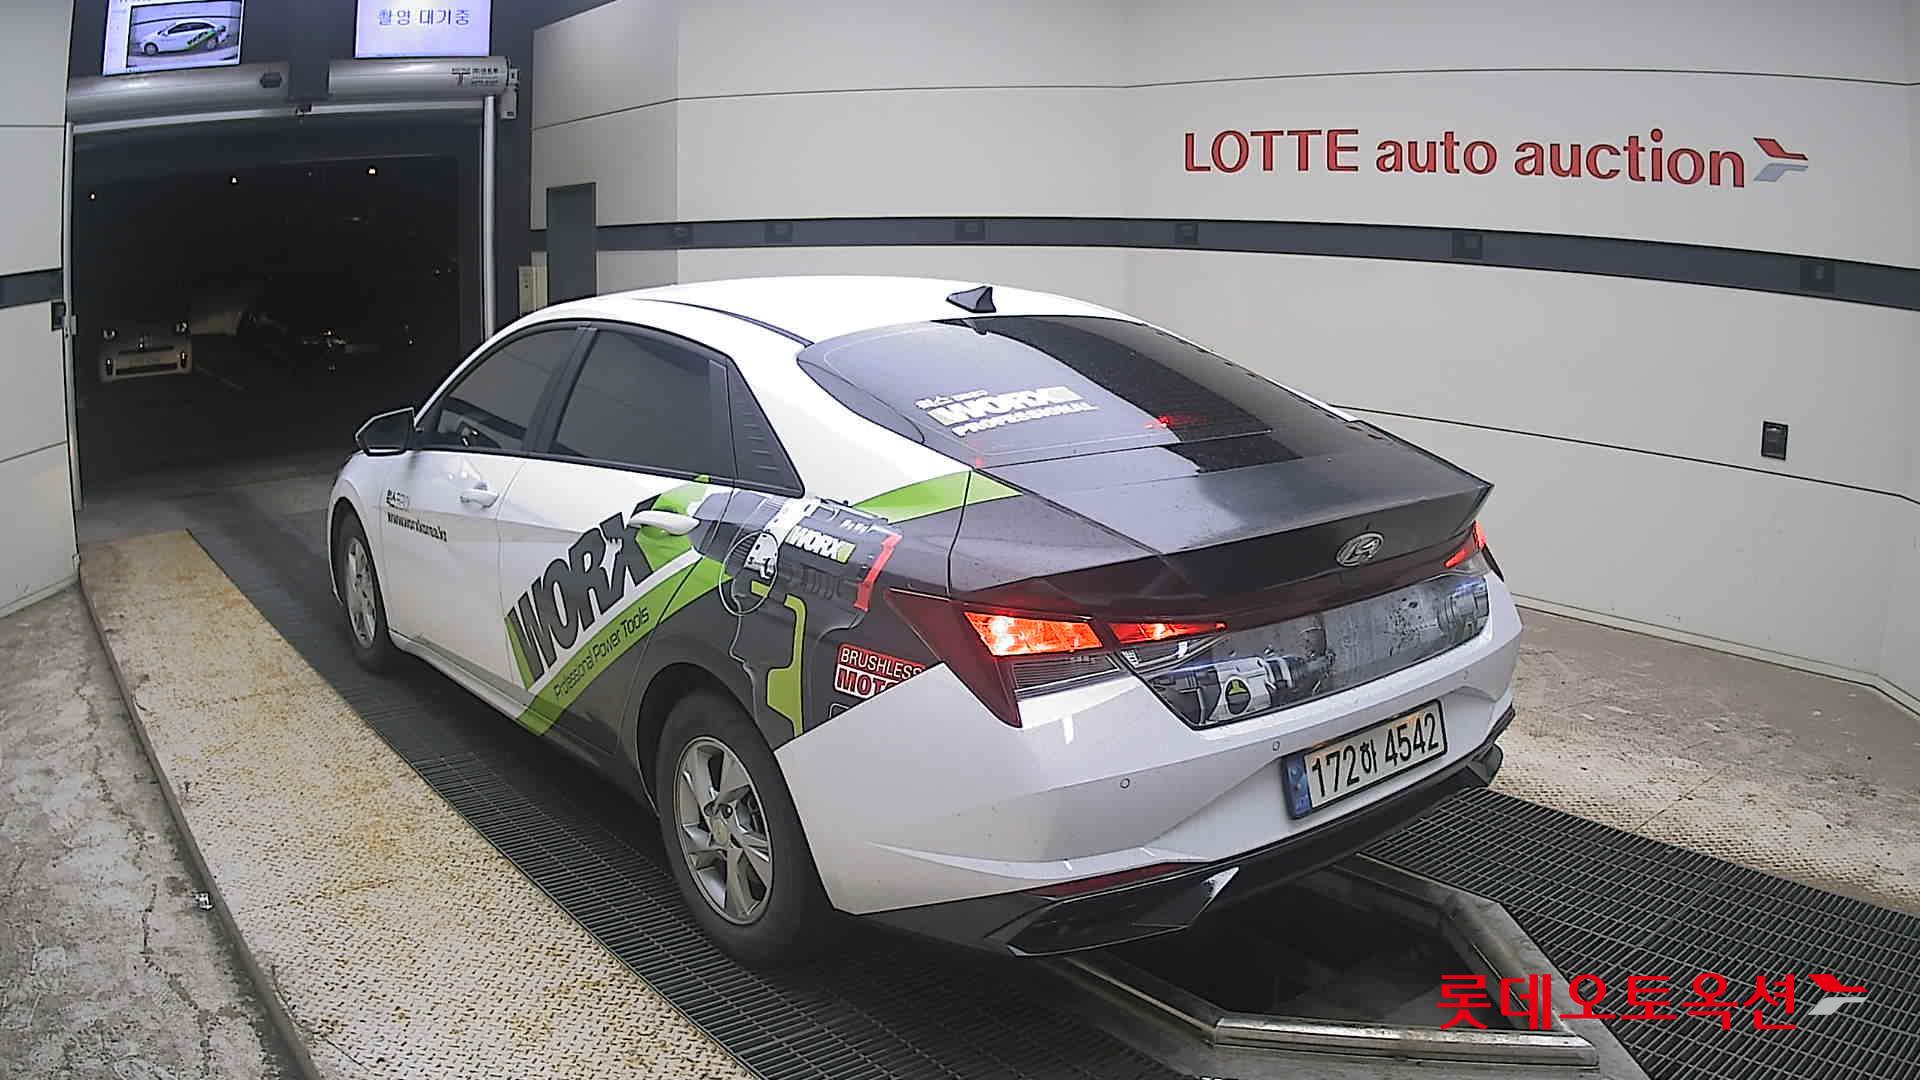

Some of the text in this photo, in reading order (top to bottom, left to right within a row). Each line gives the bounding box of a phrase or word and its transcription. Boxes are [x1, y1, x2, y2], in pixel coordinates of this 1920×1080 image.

[419, 8, 470, 26] 대기중
[1184, 127, 1746, 188] LOTTE auto auction
[785, 525, 842, 561] WORX
[506, 493, 662, 682] WORX
[592, 628, 621, 663] Power
[619, 606, 651, 638] Tools
[1311, 712, 1440, 798] 172하 4542
